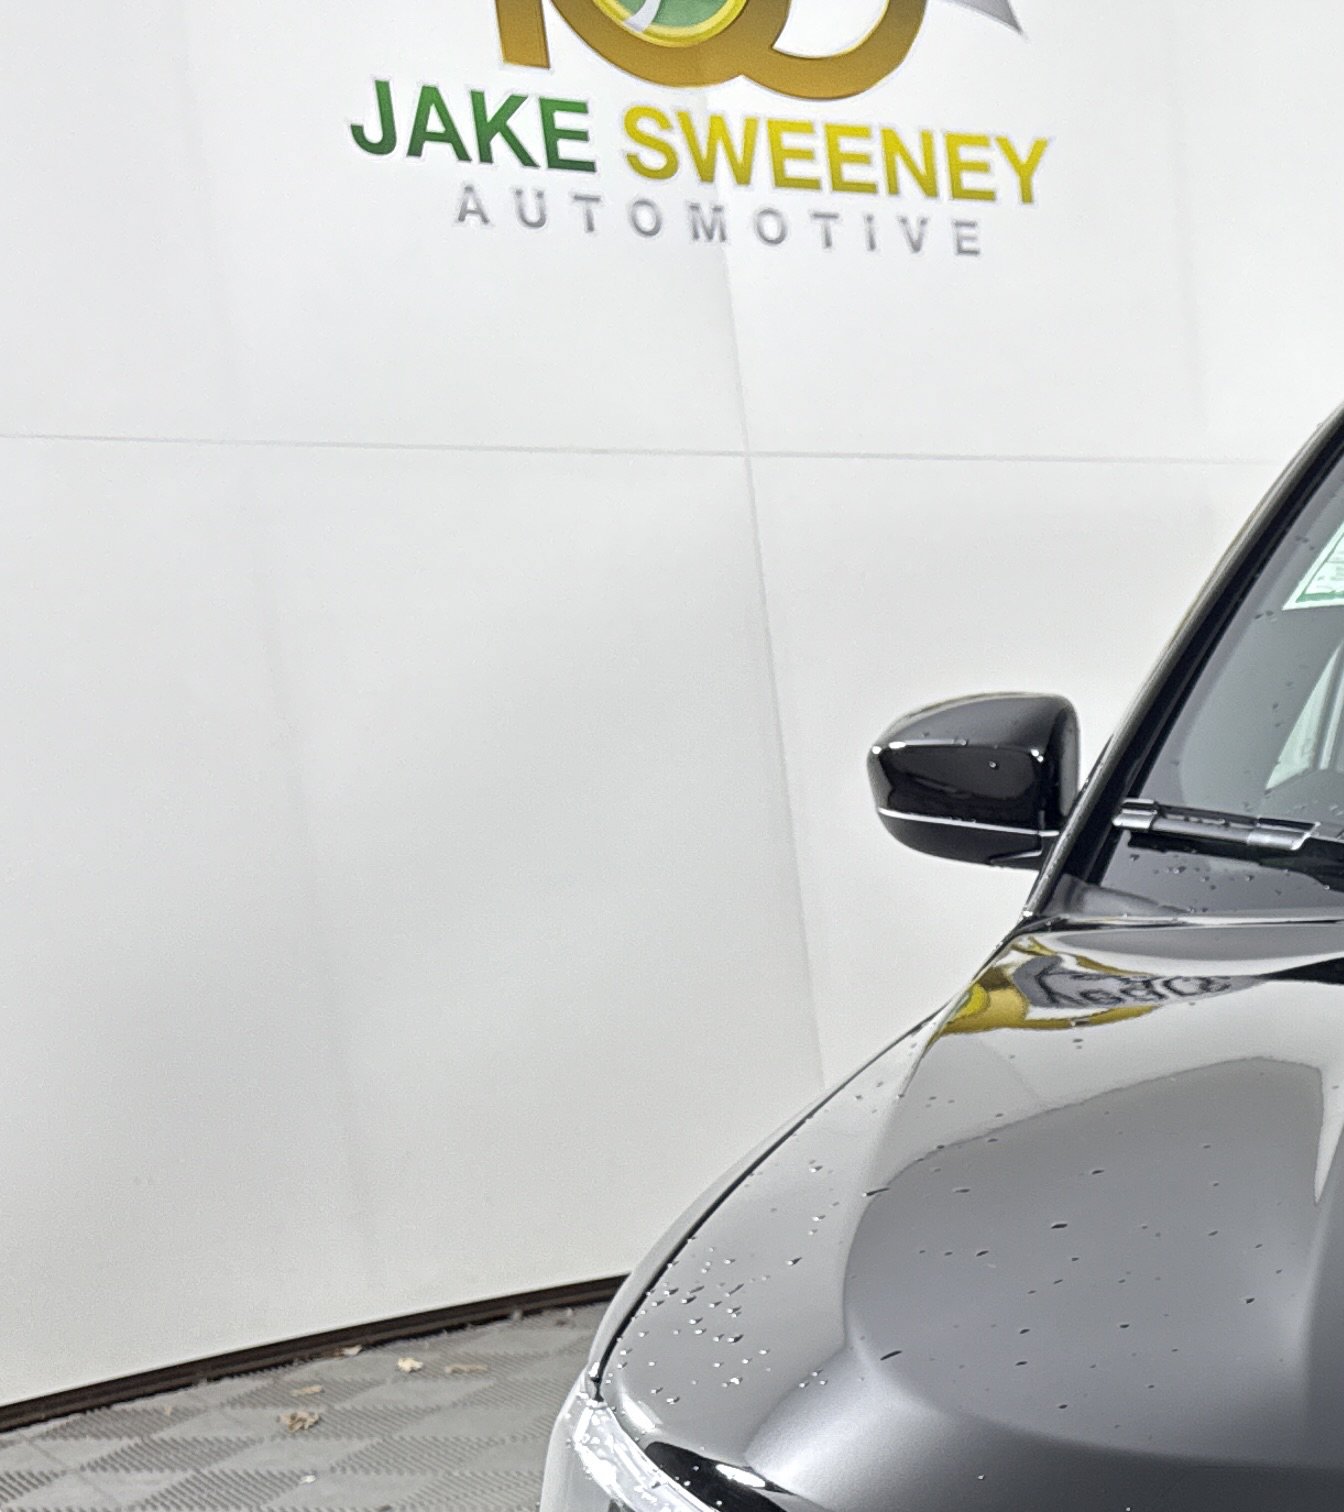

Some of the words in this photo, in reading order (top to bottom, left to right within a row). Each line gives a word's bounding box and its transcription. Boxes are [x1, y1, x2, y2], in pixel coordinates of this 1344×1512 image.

[350, 79, 597, 173] JAKE
[622, 105, 1049, 205] SWEENEY
[455, 184, 982, 257] AUTOMOTIVE
